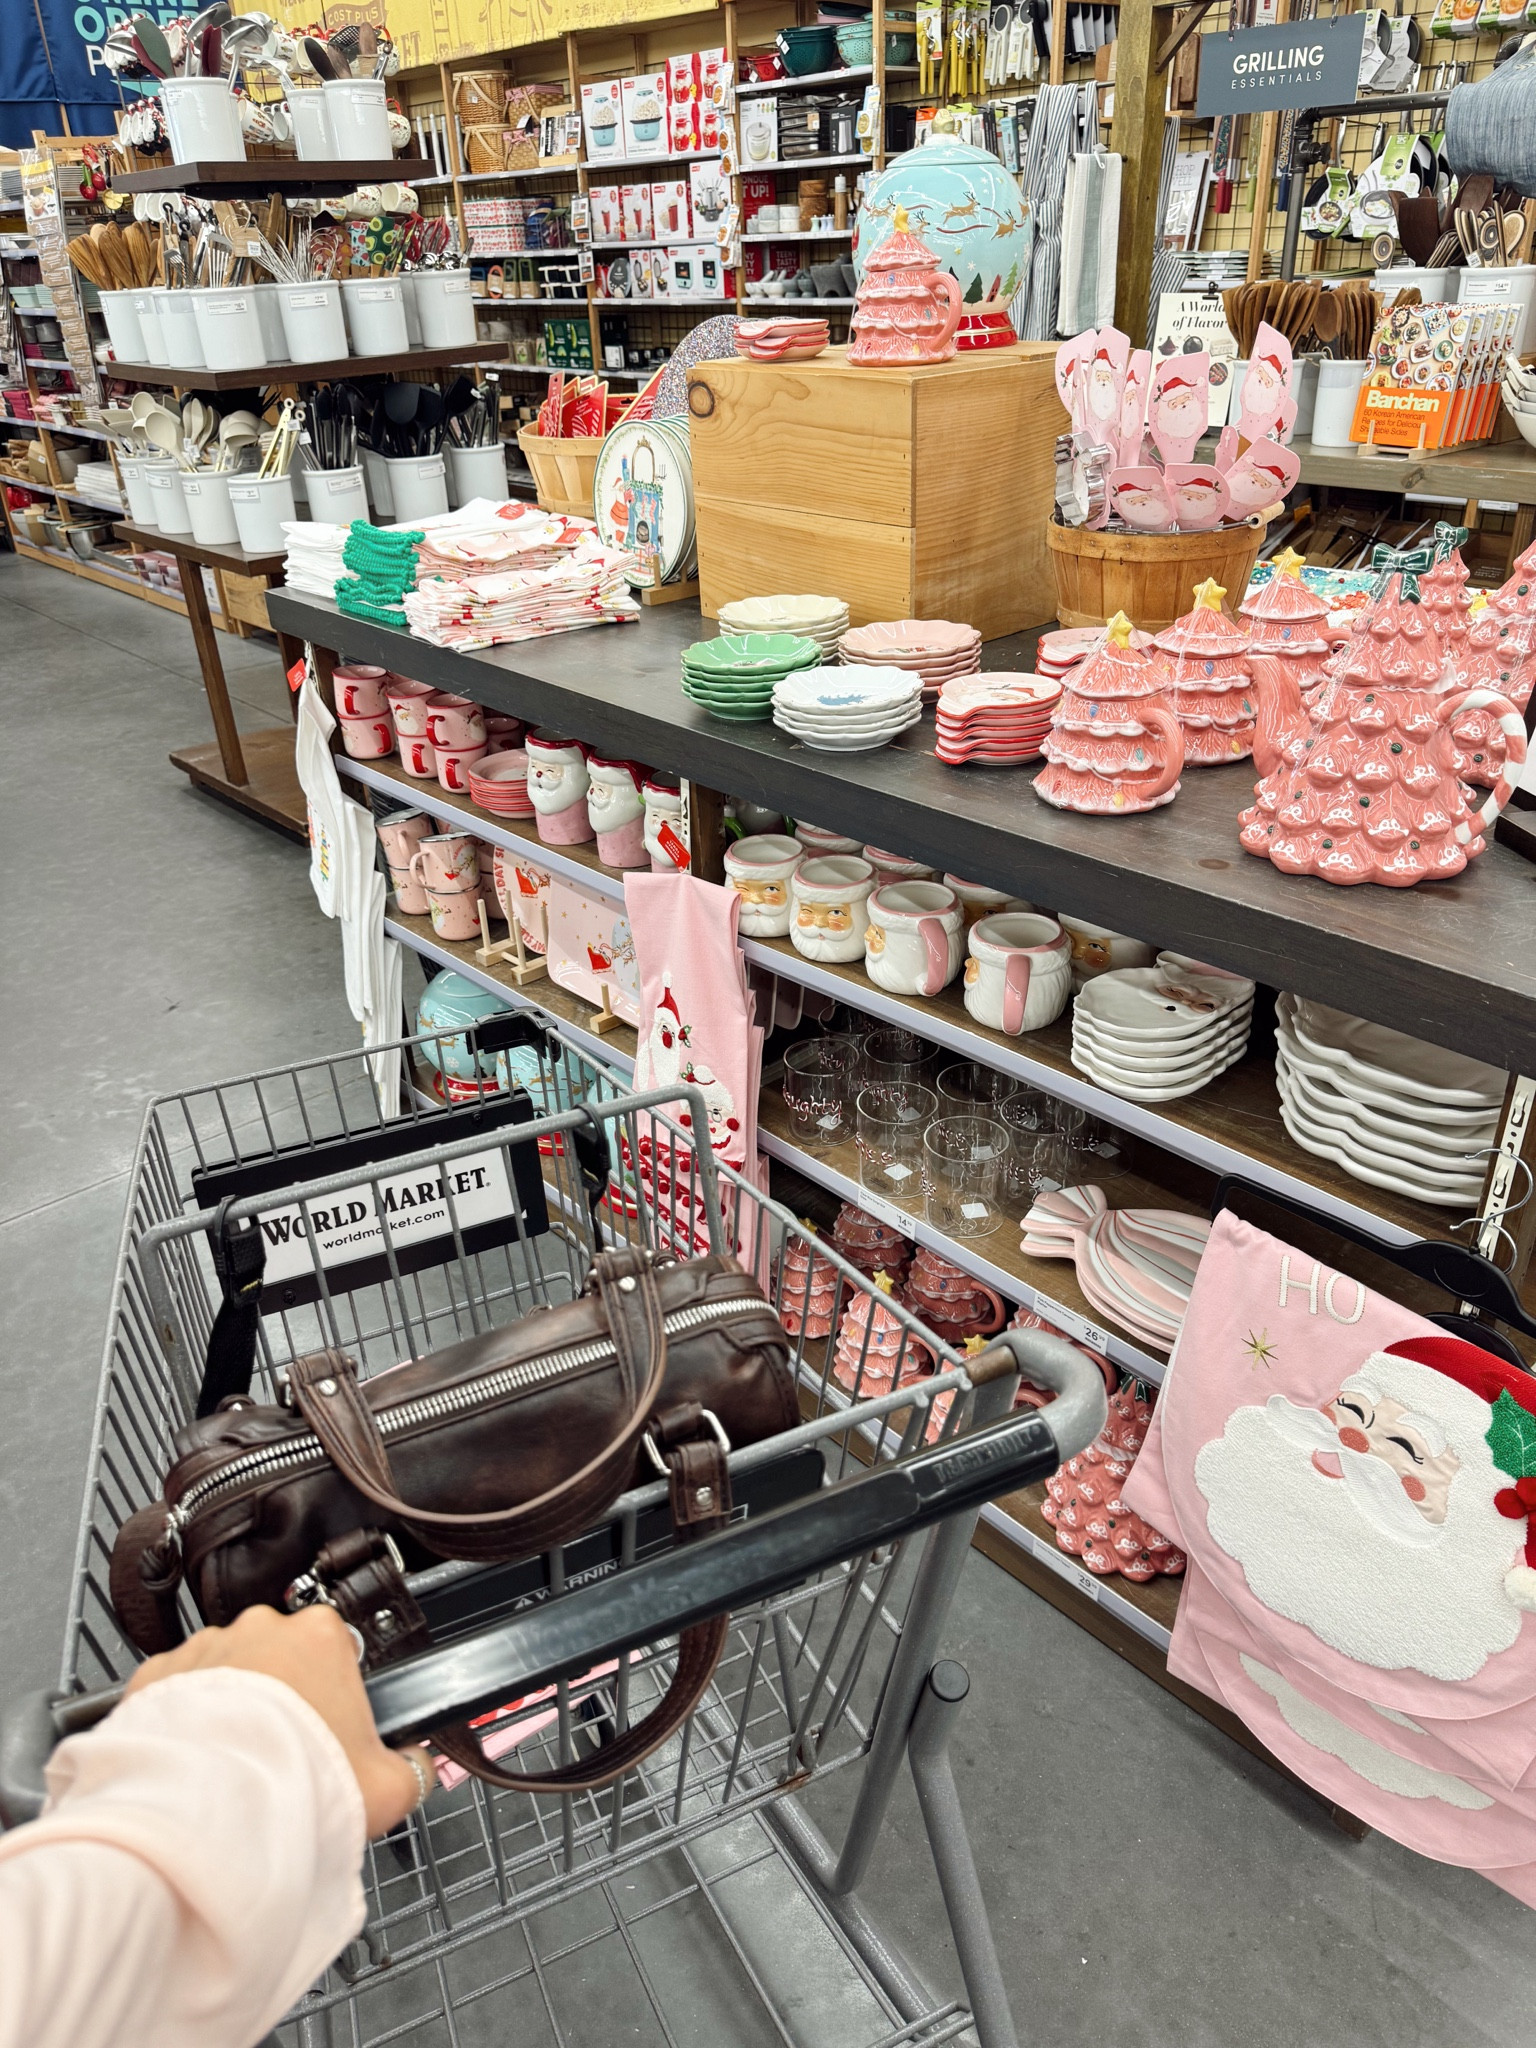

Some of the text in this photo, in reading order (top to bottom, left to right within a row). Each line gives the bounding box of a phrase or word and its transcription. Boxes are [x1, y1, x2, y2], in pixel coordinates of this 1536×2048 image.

[328, 6, 379, 26] COST PLUS
[1233, 45, 1325, 75] GRILLING
[1231, 70, 1323, 90] ESSENTIALS
[750, 185, 769, 198] UP!
[1172, 316, 1188, 331] of
[1365, 389, 1440, 413] Banchan
[1363, 408, 1426, 421] 60 Korean American
[260, 1200, 367, 1247] WORLD
[323, 1208, 445, 1251] worldmaket.com
[1277, 1255, 1367, 1326] HO
